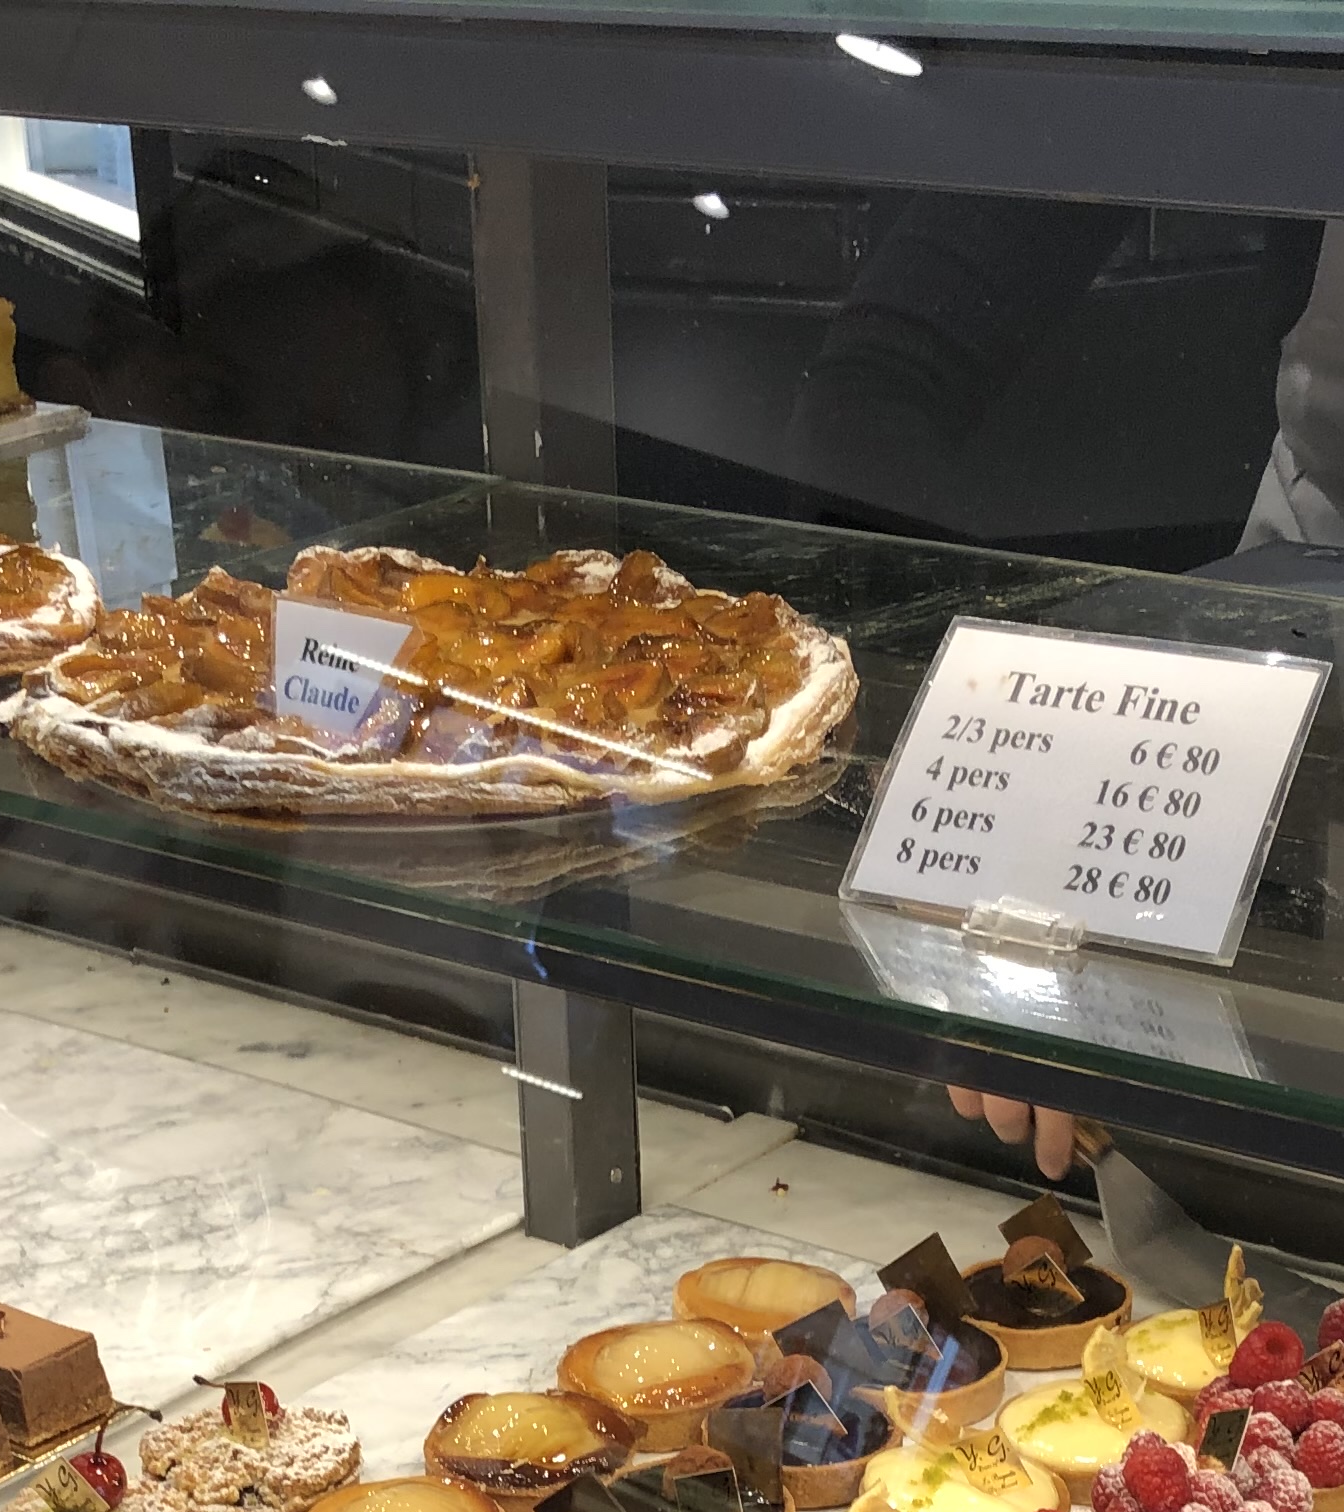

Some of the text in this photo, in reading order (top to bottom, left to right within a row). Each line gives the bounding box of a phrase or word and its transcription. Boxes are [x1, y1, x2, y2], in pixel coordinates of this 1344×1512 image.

[299, 636, 359, 672] Reine
[284, 675, 359, 714] Claude
[1006, 671, 1201, 725] Tarte Fine
[941, 714, 1221, 776] 2/3 pers 6 € 80
[926, 755, 1201, 818] 4 pers 16 € 80
[911, 797, 1186, 862] 6 pers 23 € 80
[896, 837, 1172, 905] 8 pers 28 € 80
